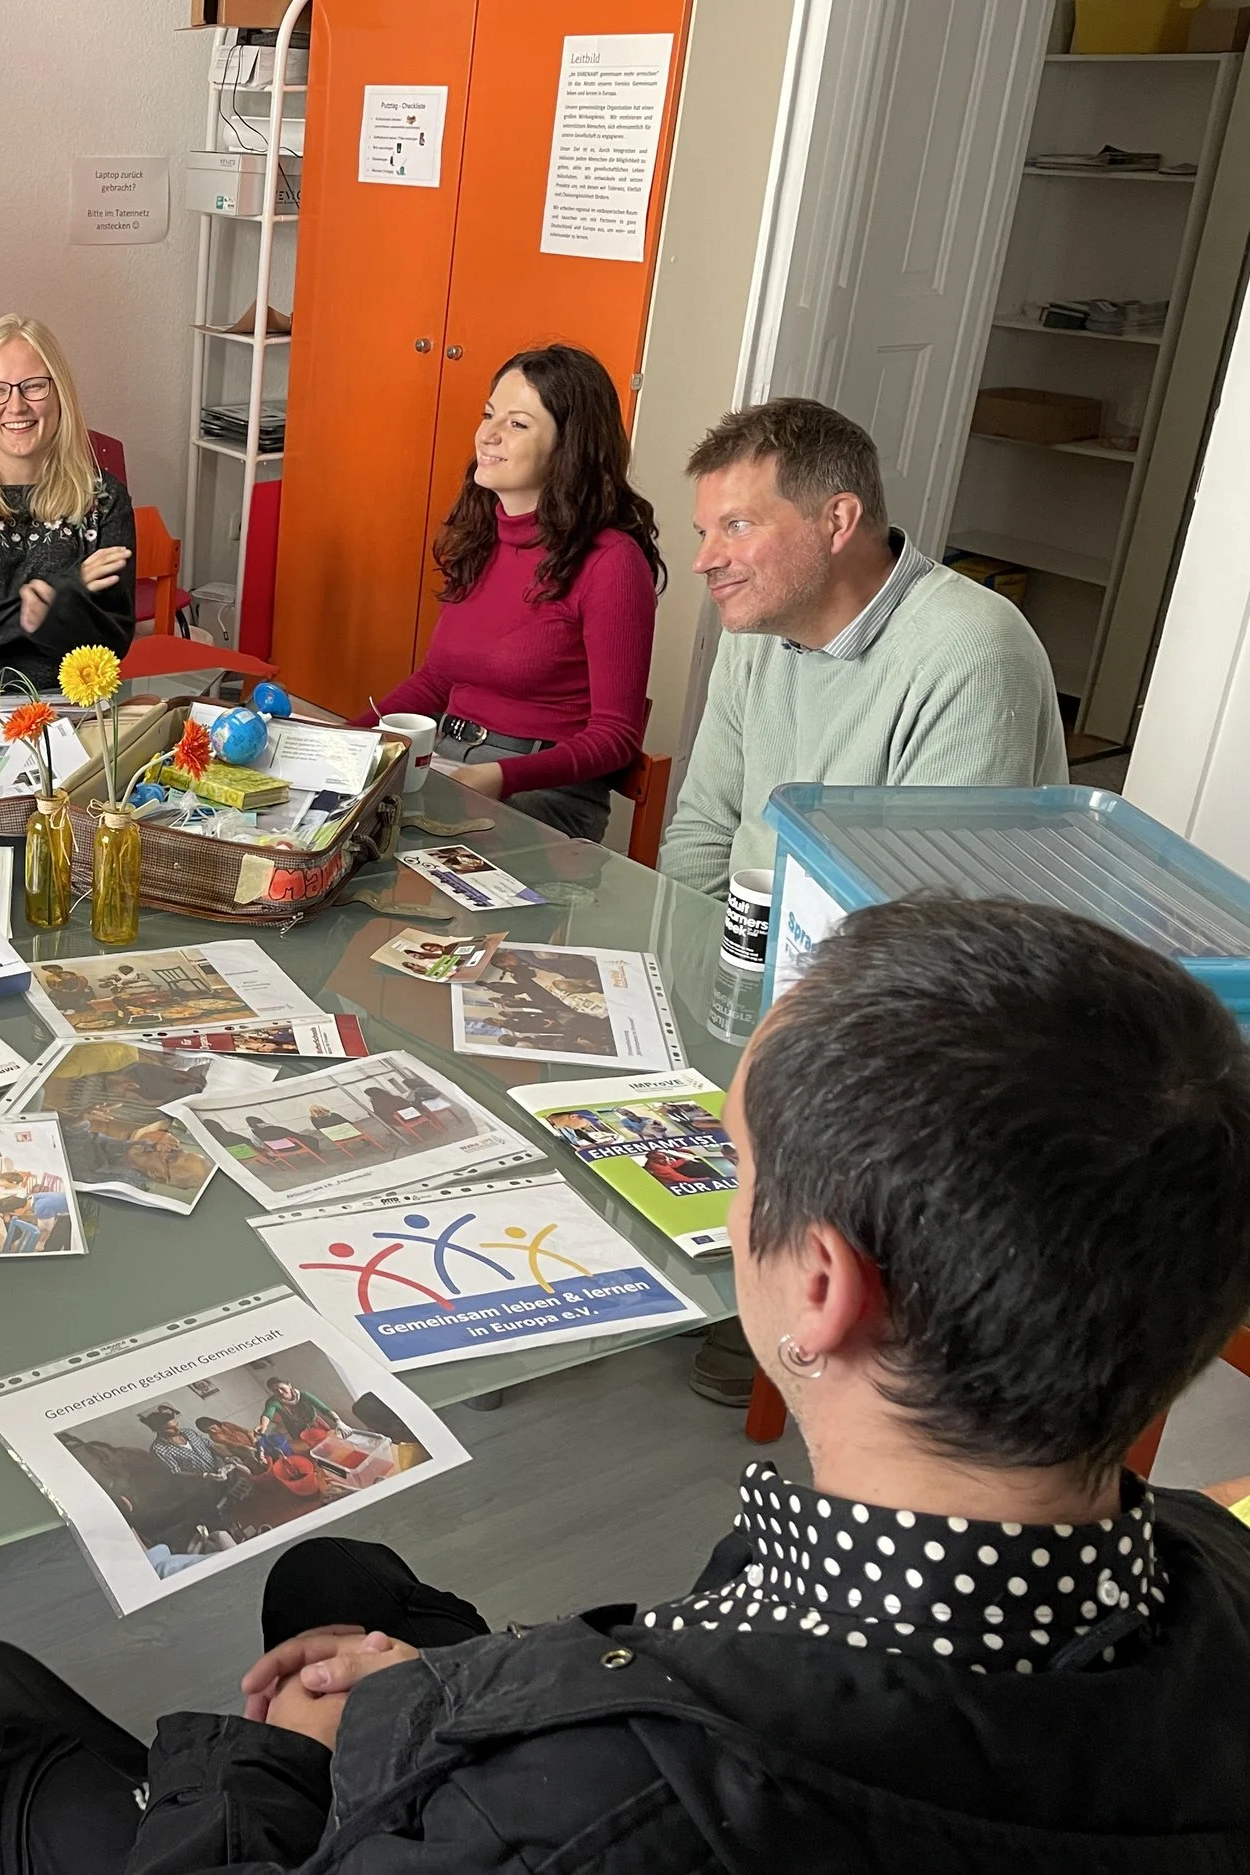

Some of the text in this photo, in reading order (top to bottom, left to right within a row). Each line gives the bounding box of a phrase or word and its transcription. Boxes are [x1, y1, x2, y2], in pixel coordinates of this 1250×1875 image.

[571, 53, 600, 64] Leitbild
[381, 102, 398, 110] Putztag
[95, 171, 143, 180] Laptop zurück
[102, 183, 136, 193] gebracht?
[87, 209, 103, 217] Bitte
[97, 222, 130, 230] anstecken
[726, 908, 769, 931] earners
[788, 911, 815, 952] Spra
[588, 1134, 718, 1159] EHRENAMT IST
[670, 1179, 739, 1195] FÜR AL
[378, 1279, 650, 1336] Gemeinsam leben & lernen
[466, 1304, 600, 1338] in Europa e.V.
[44, 1329, 285, 1421] Generationen gestalten Gemeinschaft
